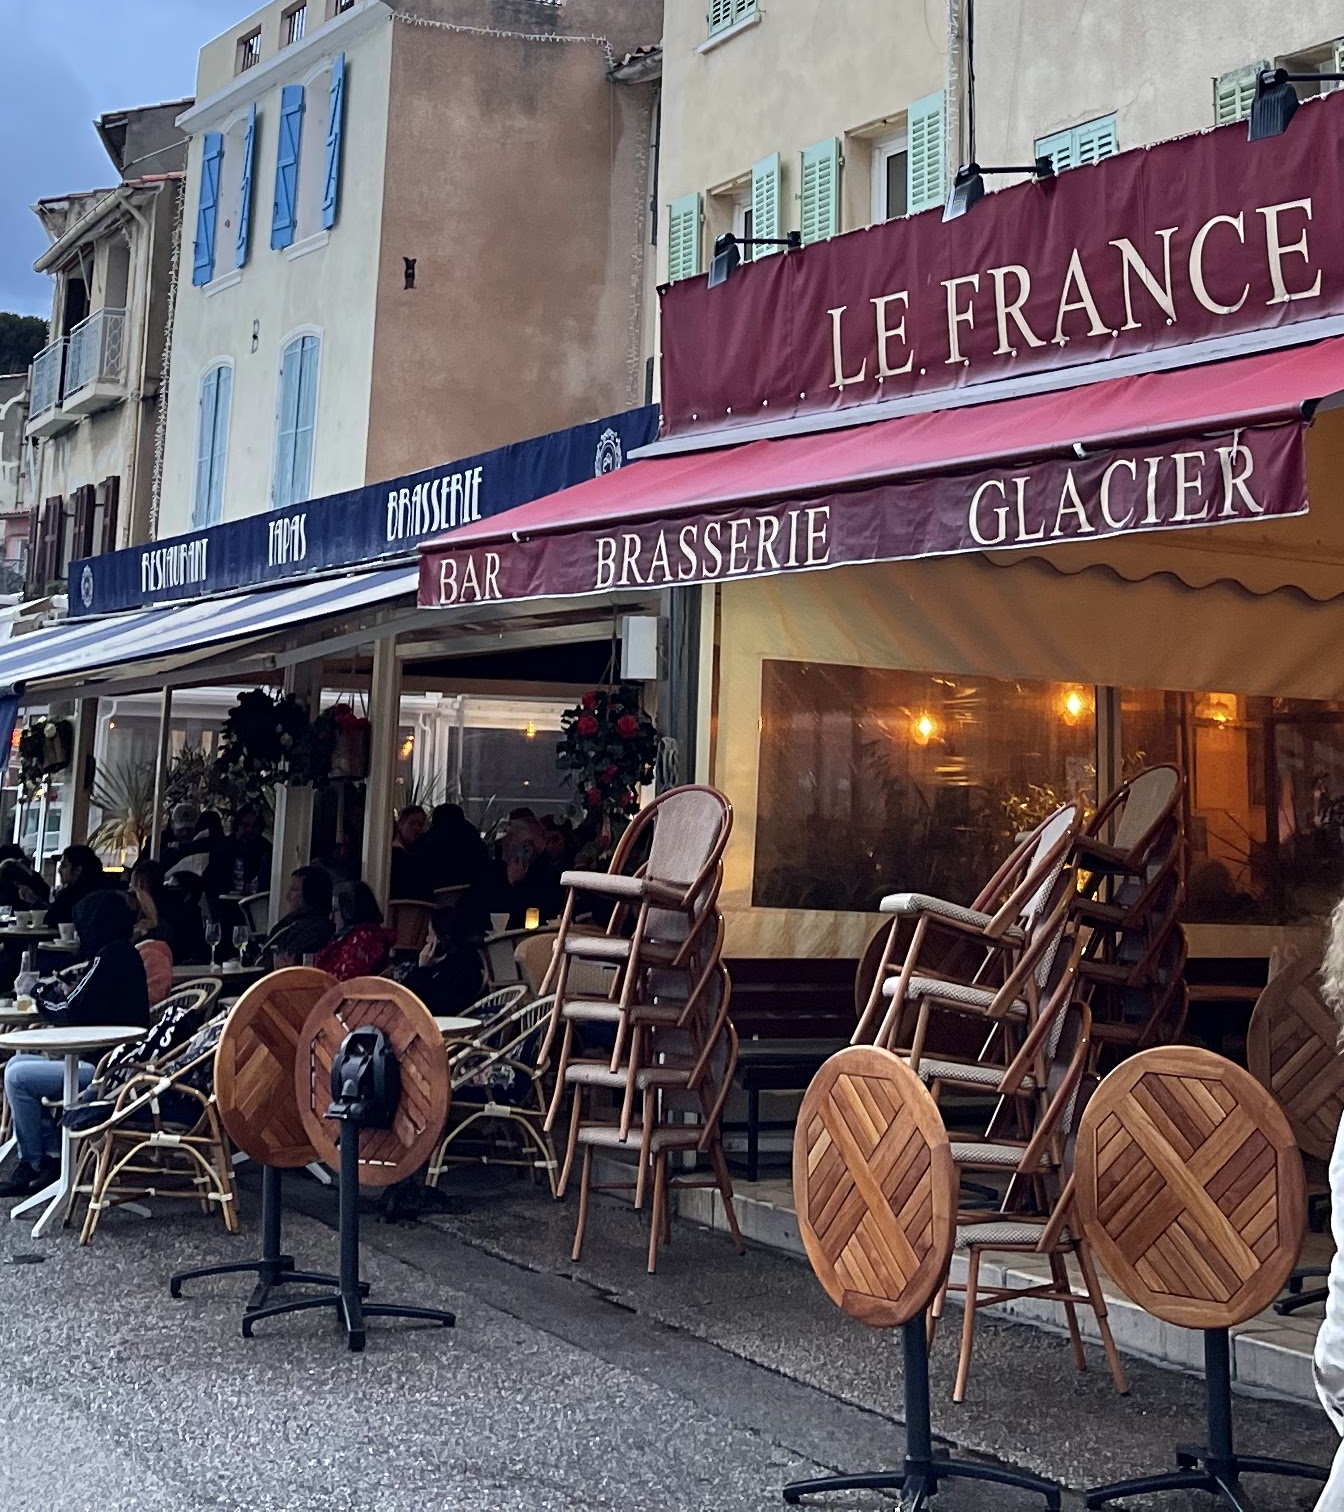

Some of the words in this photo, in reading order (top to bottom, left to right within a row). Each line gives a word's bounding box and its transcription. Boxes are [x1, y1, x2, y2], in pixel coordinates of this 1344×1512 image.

[827, 290, 915, 390] LE
[940, 197, 1322, 365] FRANCE
[141, 538, 209, 593] RESTAURANT
[268, 513, 307, 567] TAPAS
[386, 466, 484, 542] BRASSERIE
[438, 551, 503, 606] BAR
[593, 504, 832, 591] BRASSERIE
[968, 444, 1264, 545] GLACIER
